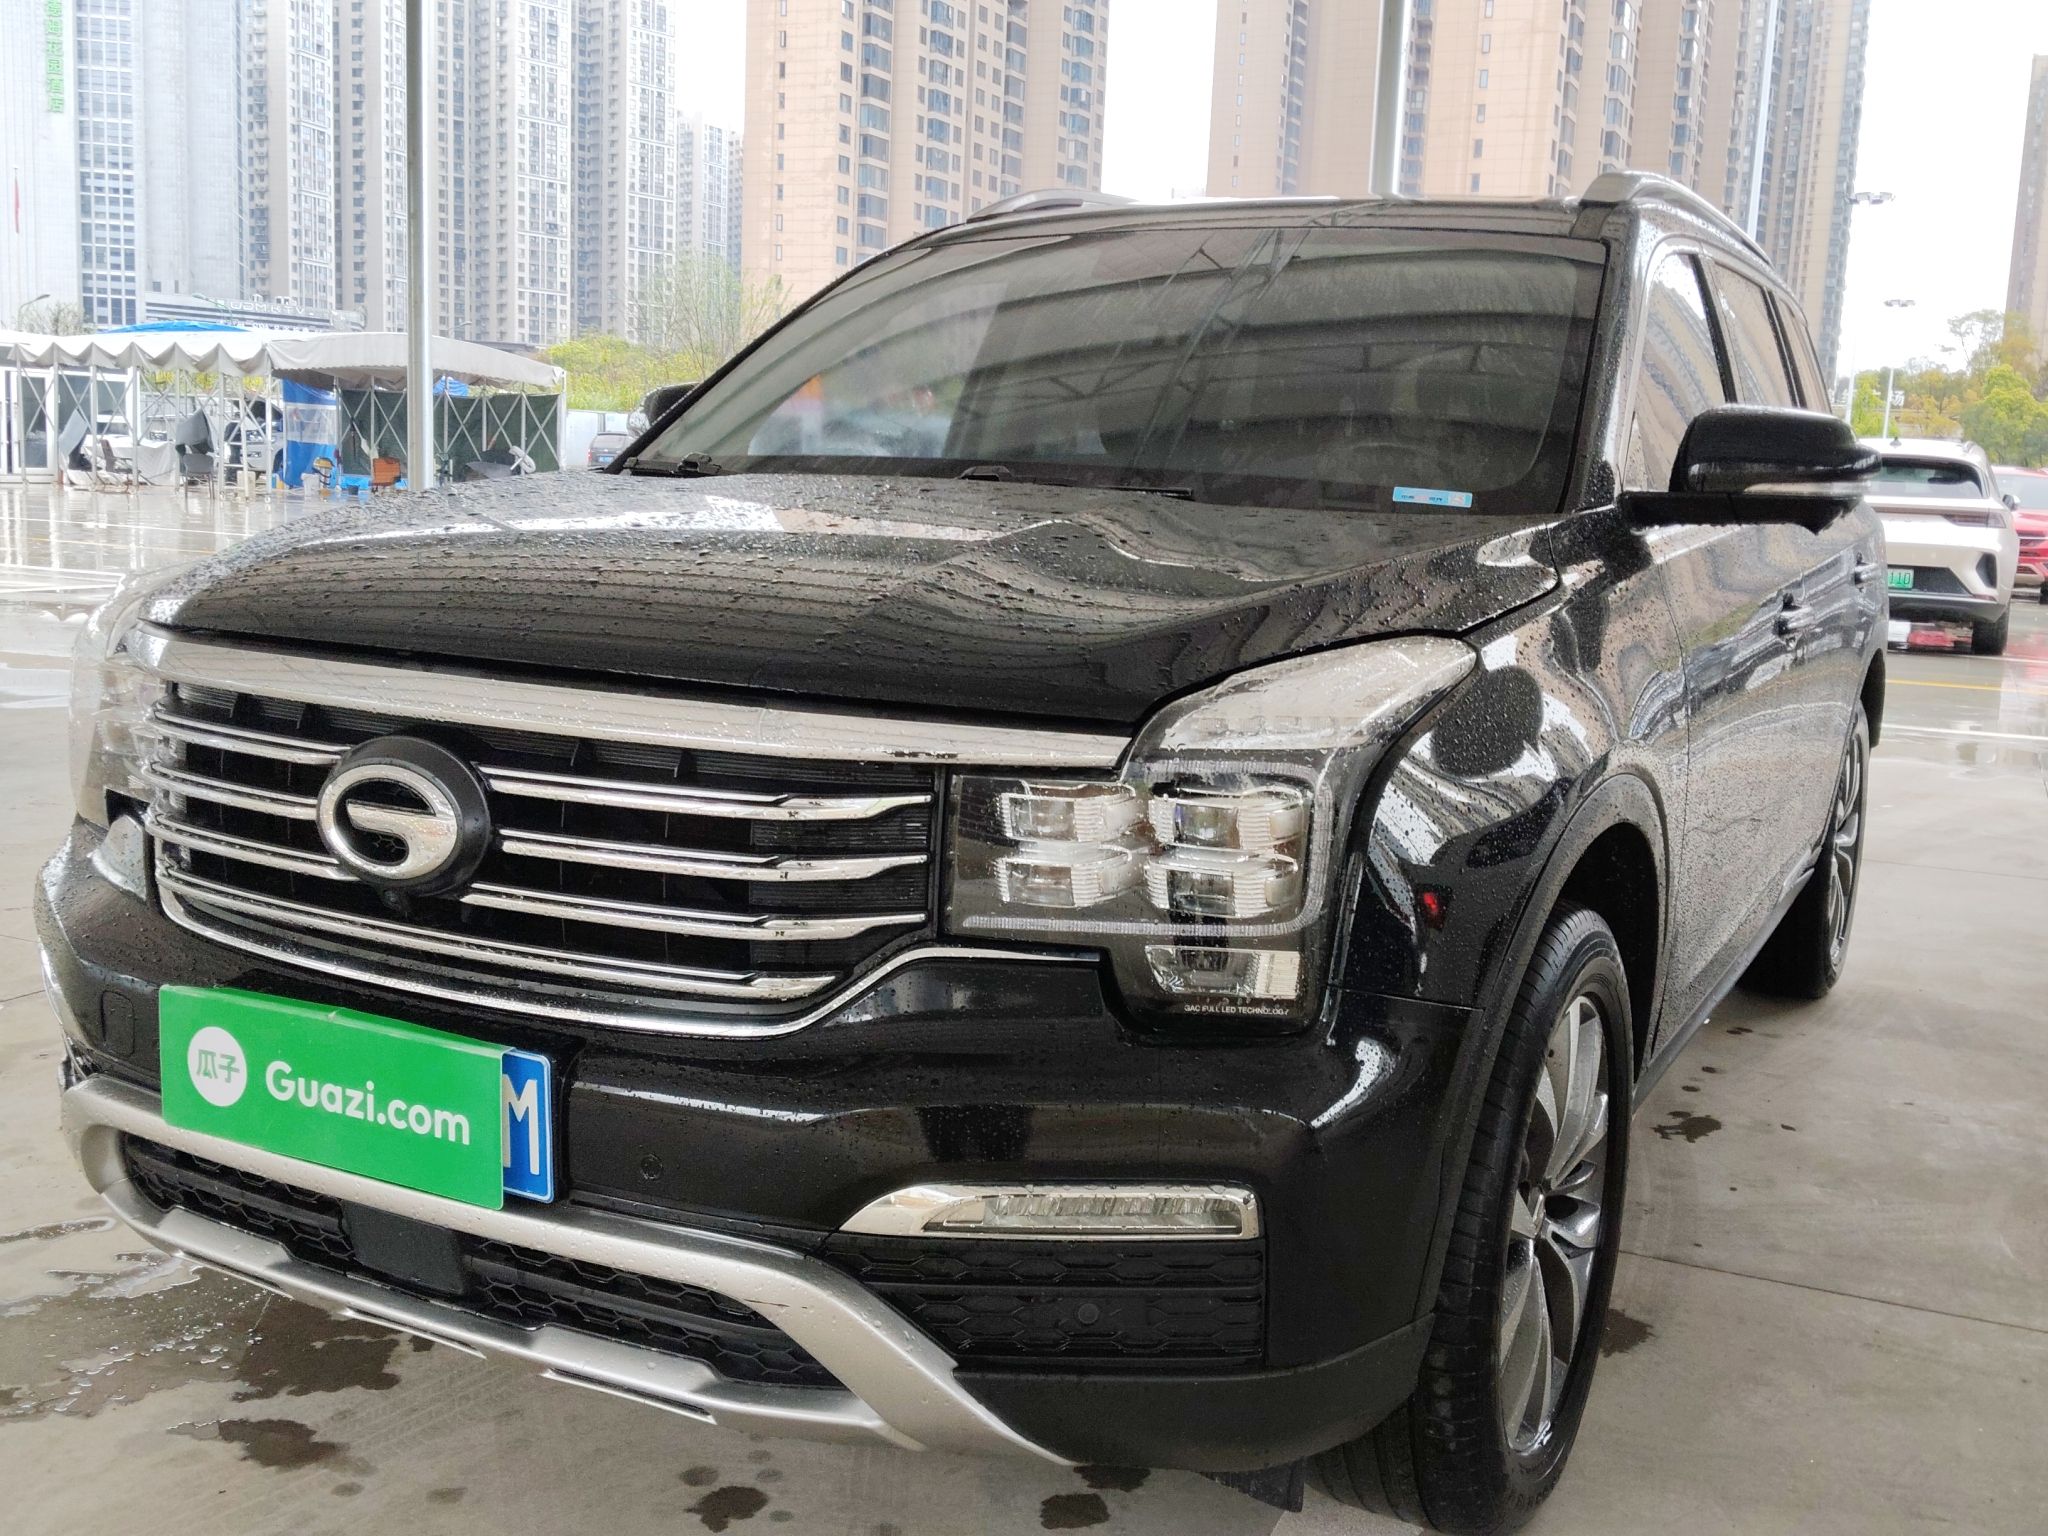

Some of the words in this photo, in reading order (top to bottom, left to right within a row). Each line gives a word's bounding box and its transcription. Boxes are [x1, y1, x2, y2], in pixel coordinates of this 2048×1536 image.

[1202, 1005, 1220, 1014] FULL
[1221, 1006, 1237, 1014] LED
[196, 1048, 240, 1084] 瓜子
[265, 1060, 471, 1146] Guazi.com
